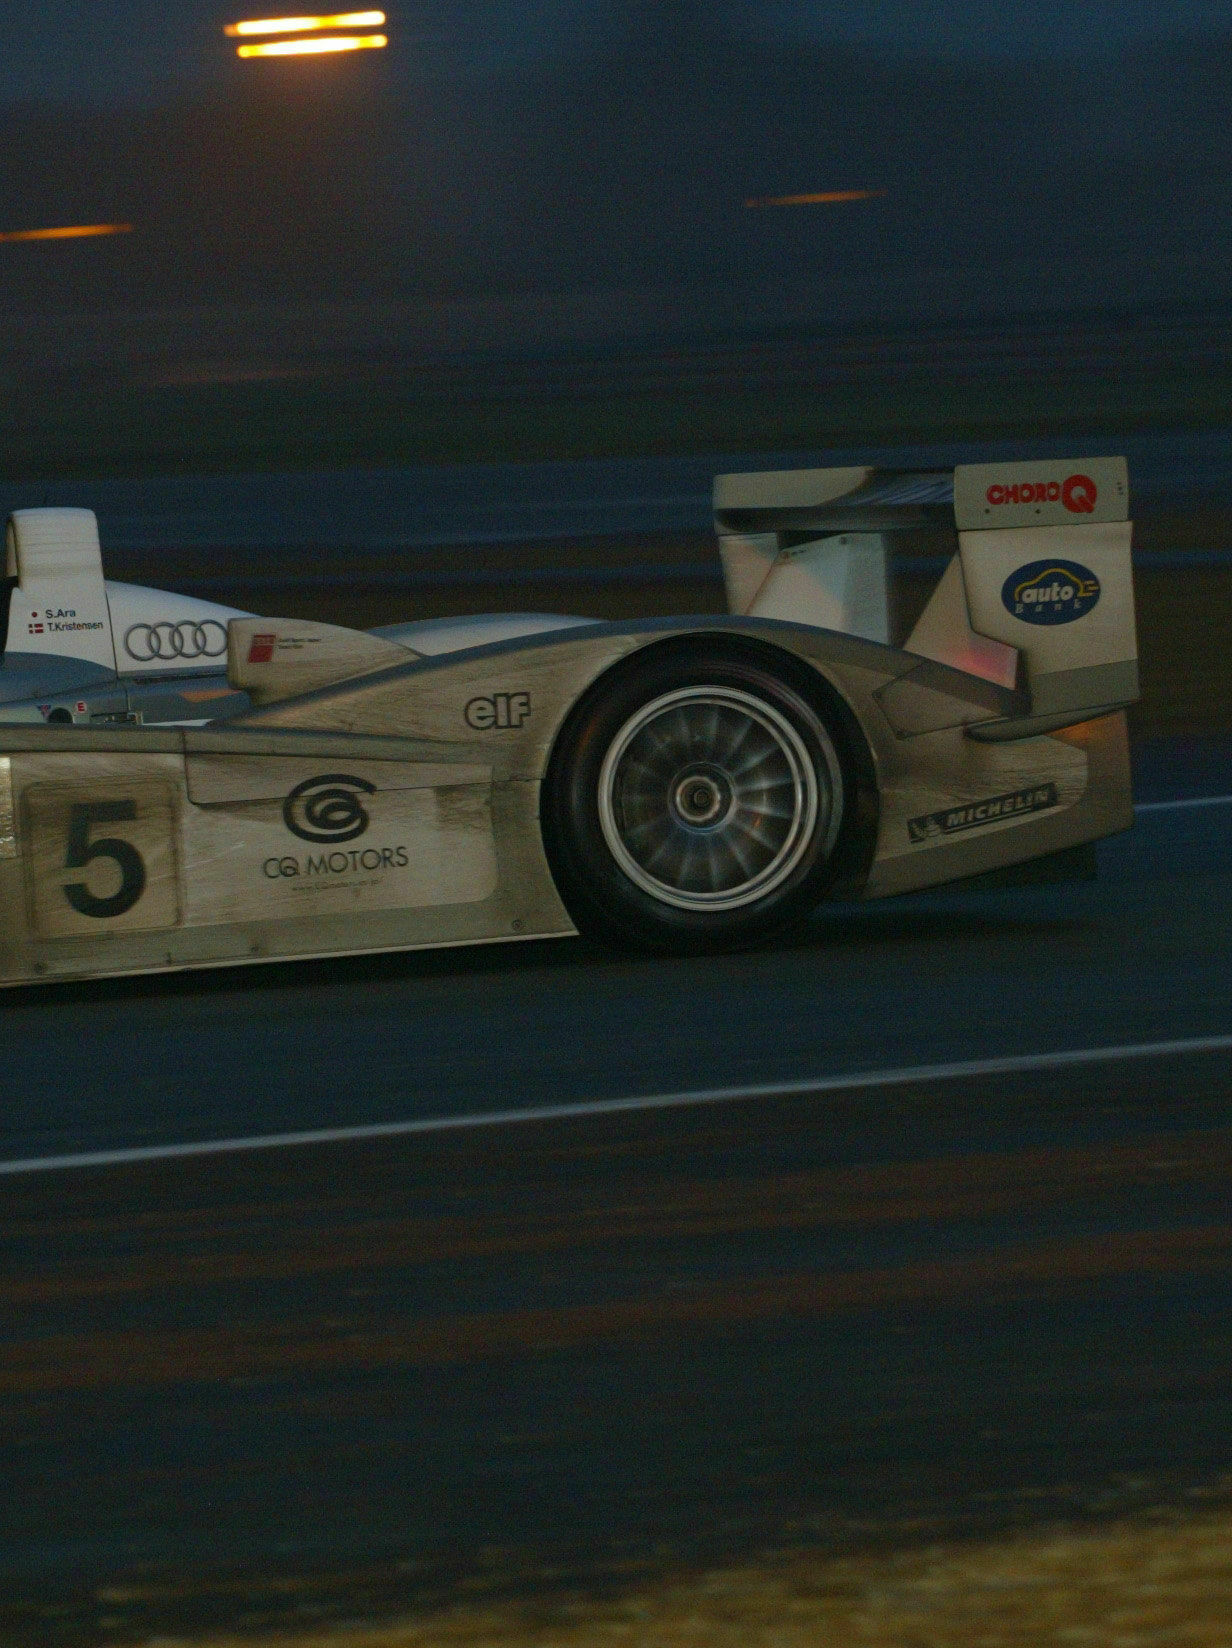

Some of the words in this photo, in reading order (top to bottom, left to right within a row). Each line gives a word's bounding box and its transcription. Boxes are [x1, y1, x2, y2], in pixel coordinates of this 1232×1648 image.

[1022, 582, 1074, 604] auto
[45, 608, 76, 619] S.Ara
[47, 622, 103, 632] T.Kristensen
[947, 790, 1049, 827] MICHELIN
[62, 799, 146, 918] 5
[307, 846, 409, 876] MOTORS
